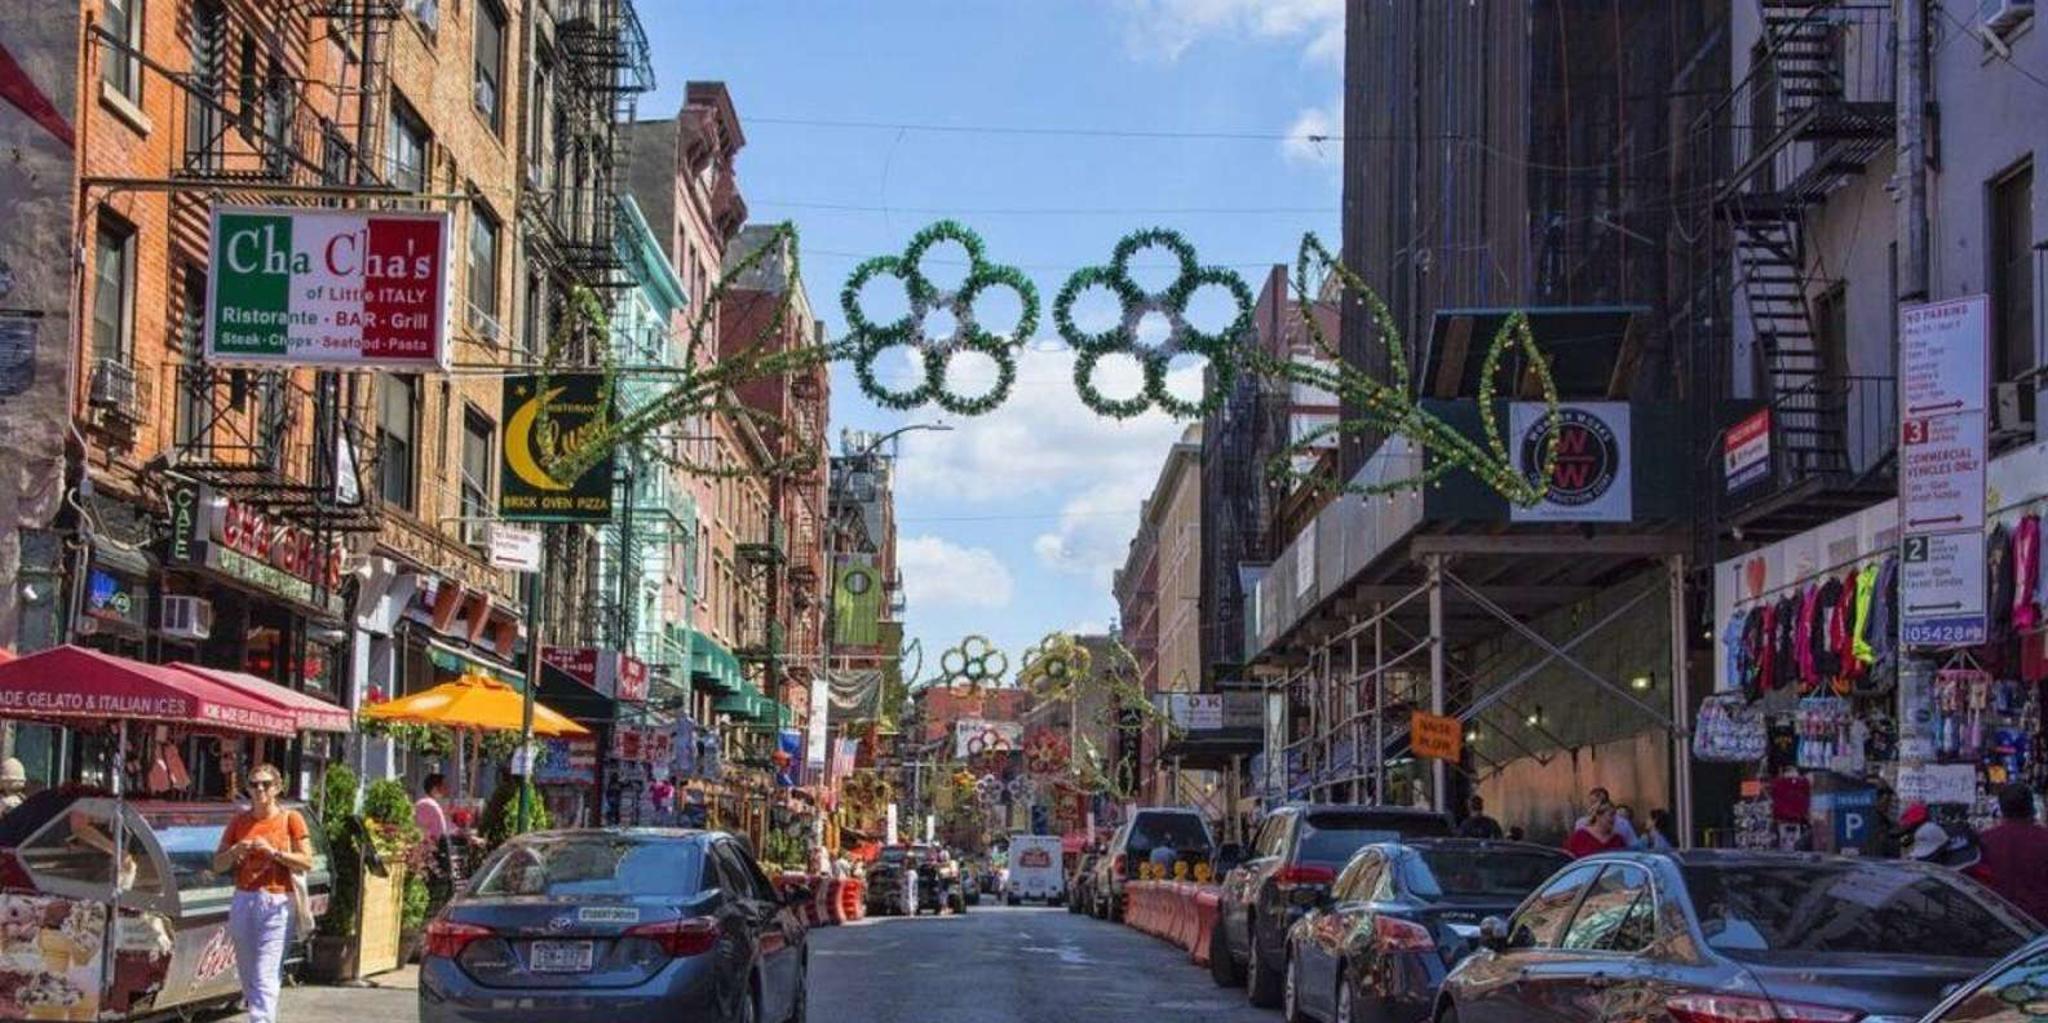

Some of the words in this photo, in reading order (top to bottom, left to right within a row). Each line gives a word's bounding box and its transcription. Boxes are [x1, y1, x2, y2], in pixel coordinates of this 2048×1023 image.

[227, 225, 312, 275] Cha
[325, 229, 432, 279] Cha's
[306, 287, 323, 301] of
[329, 288, 374, 303] Little
[379, 288, 426, 304] ITALY
[222, 307, 318, 326] Ristorante
[335, 311, 376, 327] BAR
[391, 313, 427, 329] Grill
[221, 332, 260, 346] Steak
[269, 333, 312, 349] Chops
[322, 335, 380, 350] Seafood
[389, 337, 427, 351] Pasta
[1910, 420, 1922, 442] 3
[1908, 447, 1972, 464] COMMERCIAL
[503, 496, 537, 508] BRICK
[541, 497, 573, 509] OVEN
[577, 498, 609, 509] PIZZA
[174, 488, 195, 560] CAFE
[1909, 538, 1922, 560] 2
[27, 691, 83, 709] GELATO
[85, 695, 95, 710] &
[98, 695, 152, 714] ITALIAN
[155, 696, 186, 715] ICES
[1845, 812, 1864, 840] P
